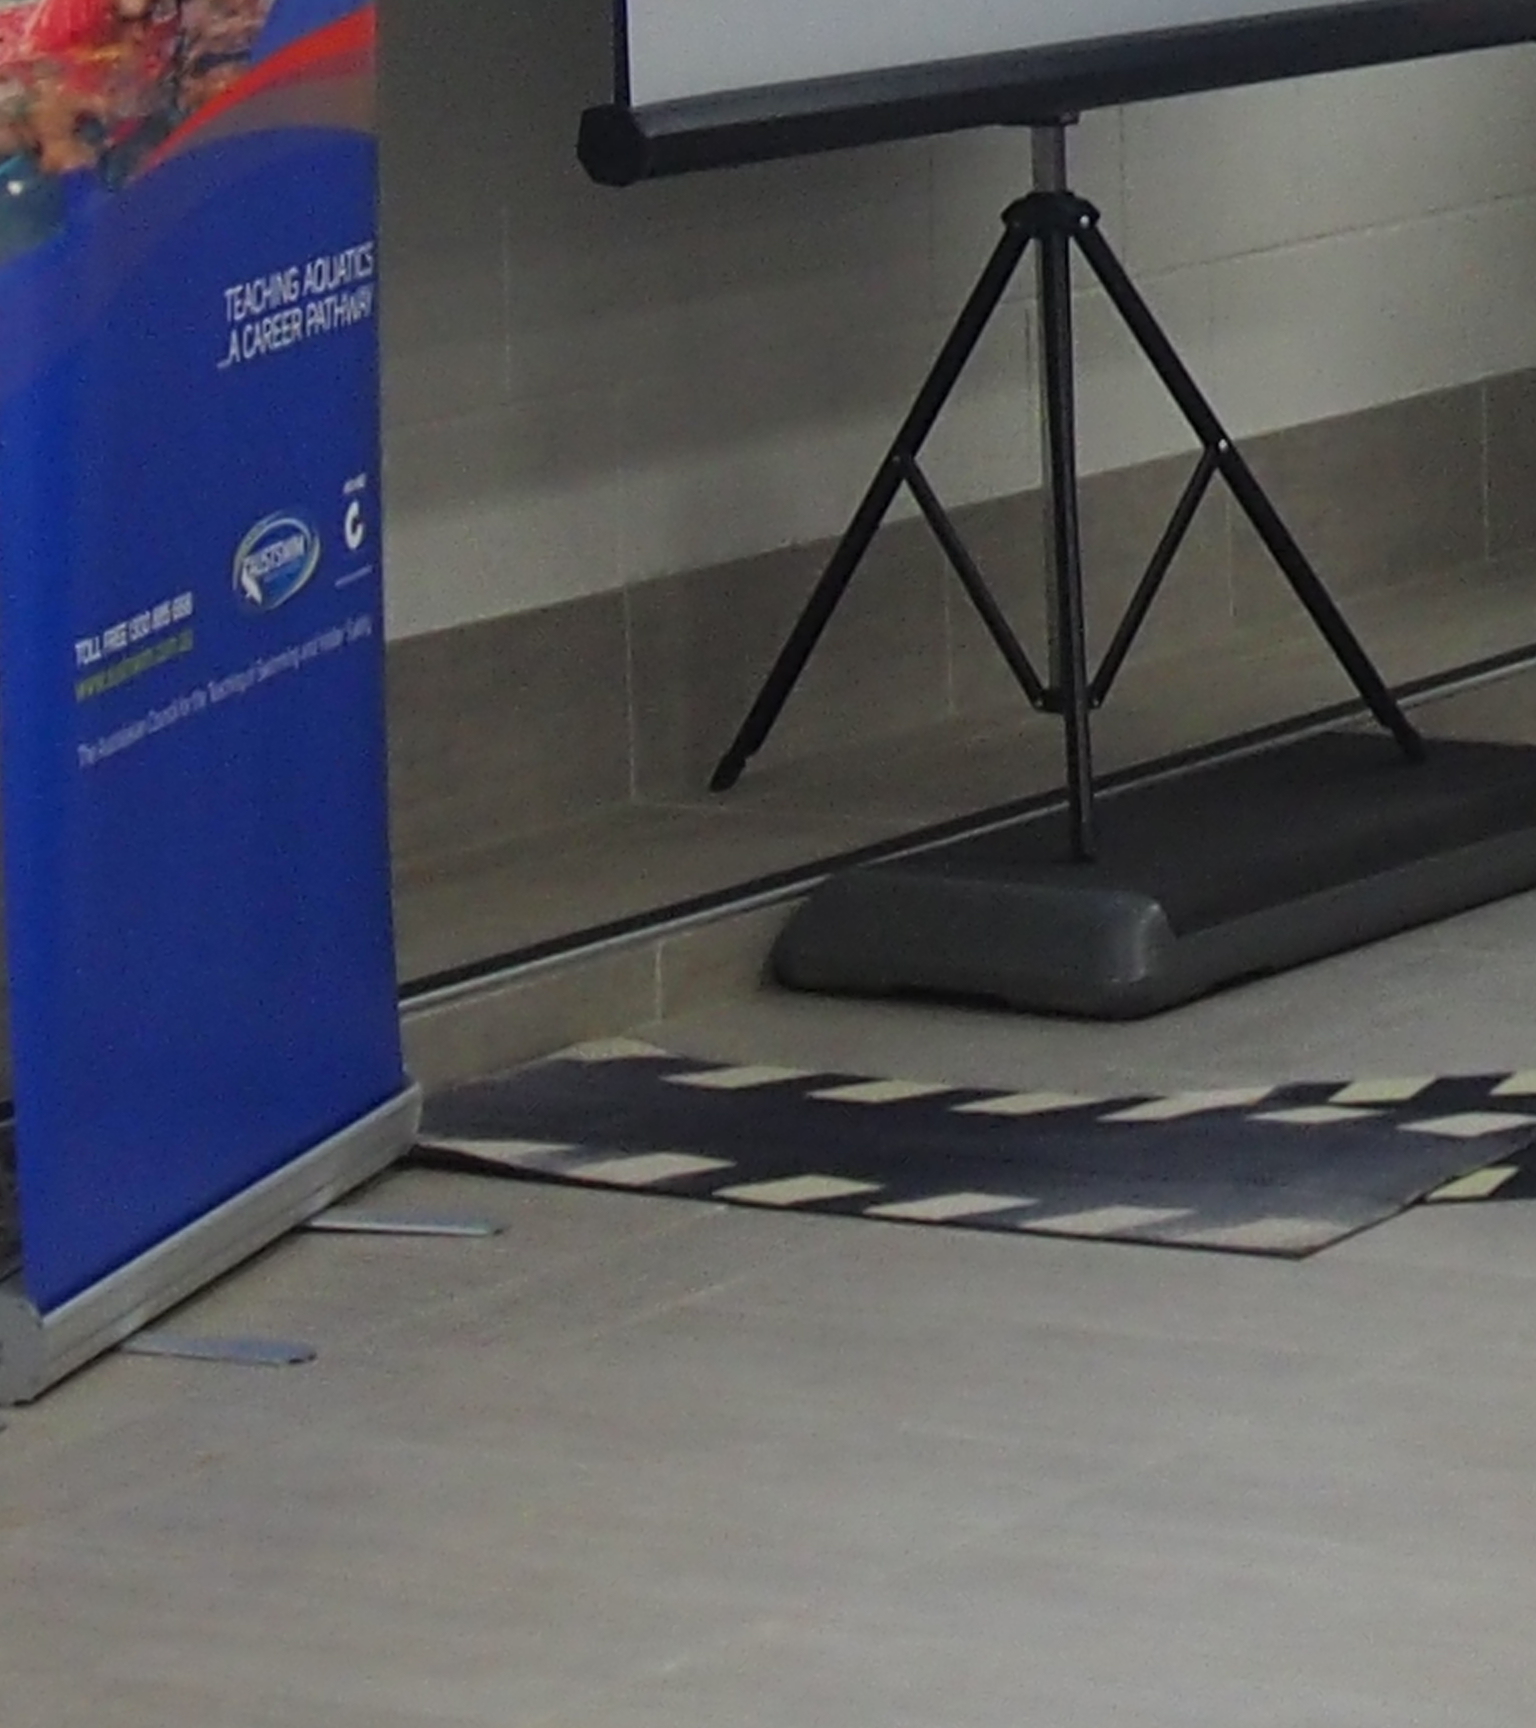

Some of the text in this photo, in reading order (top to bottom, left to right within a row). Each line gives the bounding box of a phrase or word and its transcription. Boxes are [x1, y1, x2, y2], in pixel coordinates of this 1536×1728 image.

[224, 240, 375, 322] TEACHING AQUATICS
[242, 307, 303, 360] CAREER
[305, 283, 375, 337] PATHWAY
